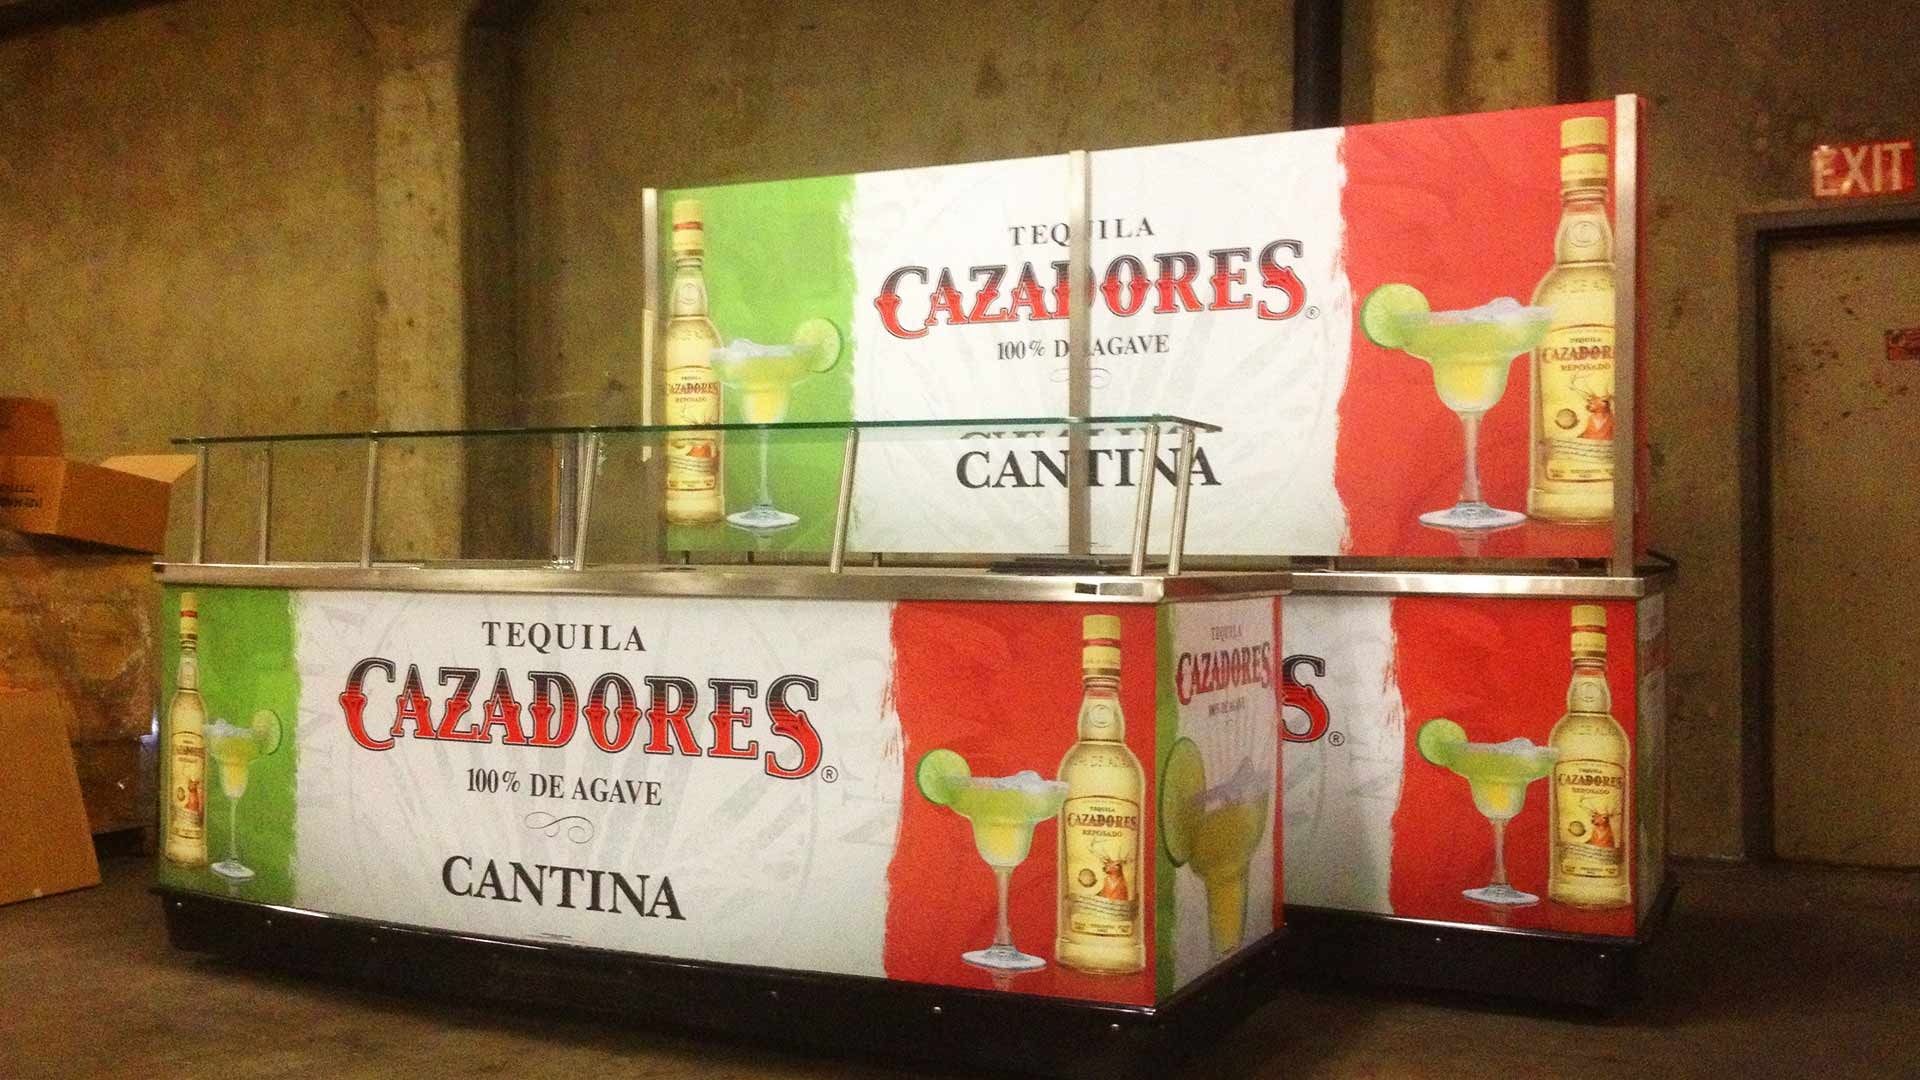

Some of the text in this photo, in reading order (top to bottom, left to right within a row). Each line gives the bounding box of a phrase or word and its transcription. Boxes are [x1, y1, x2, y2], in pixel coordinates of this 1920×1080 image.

[1813, 142, 1911, 196] EXIT
[997, 340, 1046, 361] 100%
[1090, 334, 1170, 356] AGAVE
[482, 621, 647, 652] TEQUILA
[339, 657, 824, 780] CAZADORES
[467, 768, 662, 806] 100% DE AGAVE
[442, 855, 687, 920] CANTINA
